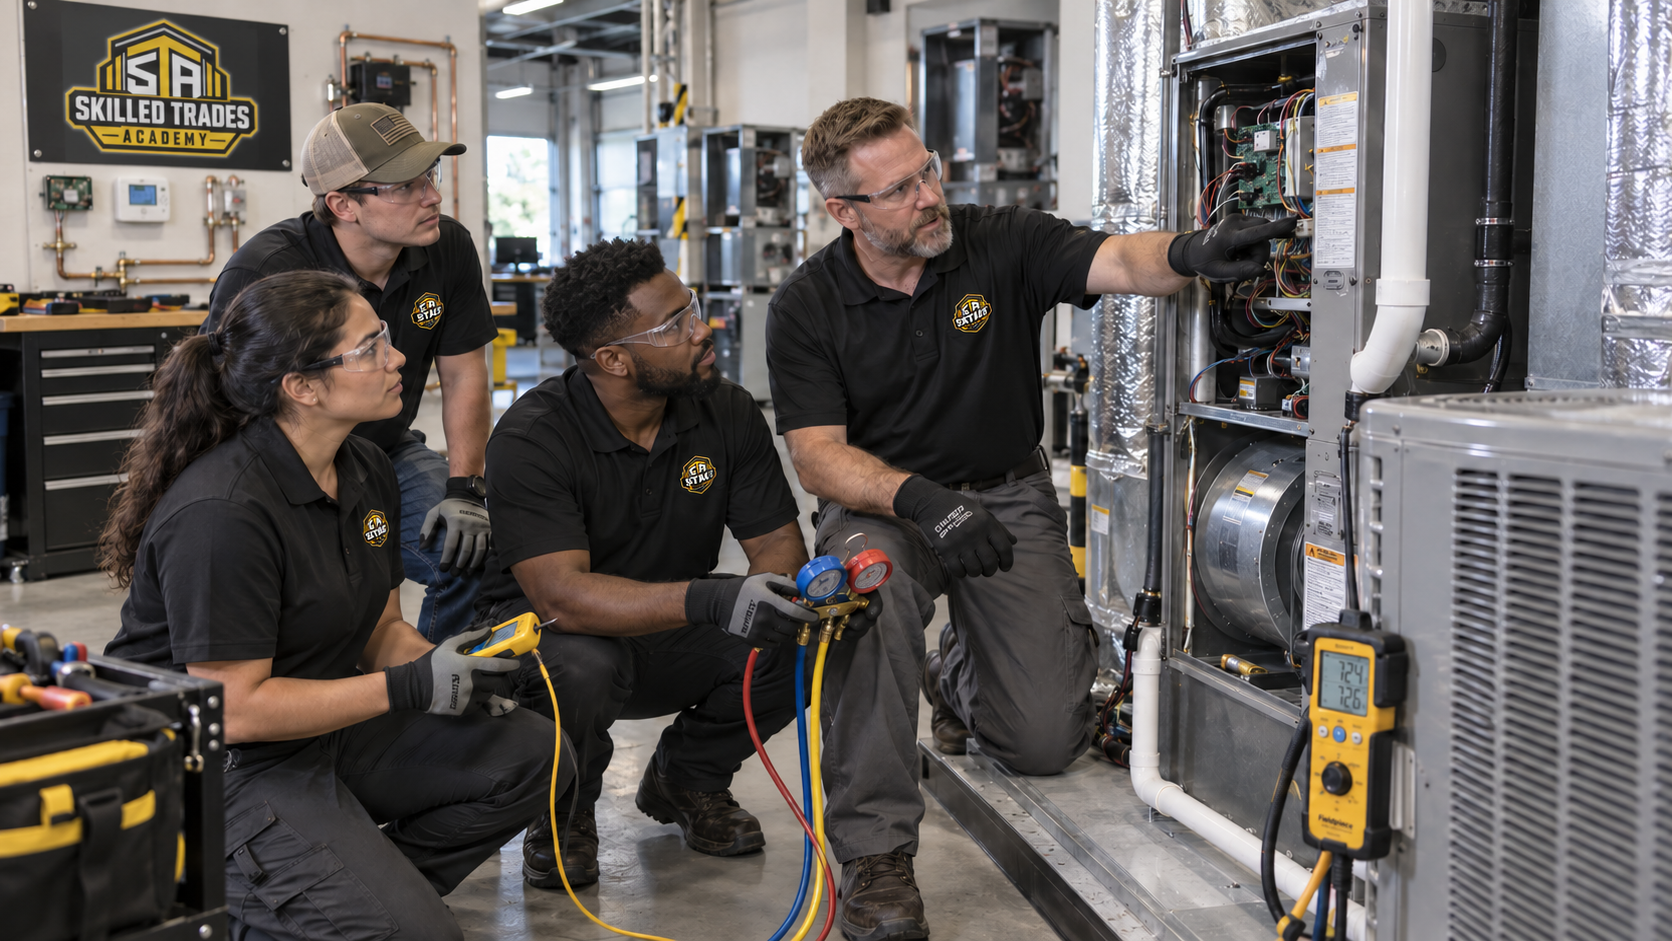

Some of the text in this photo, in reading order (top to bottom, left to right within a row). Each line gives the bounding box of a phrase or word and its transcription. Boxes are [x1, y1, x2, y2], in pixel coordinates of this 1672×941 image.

[75, 95, 250, 130] SKILLED TRADES
[122, 129, 207, 147] ACADEMY
[1338, 660, 1364, 685] 724
[1338, 685, 1361, 710] 726
